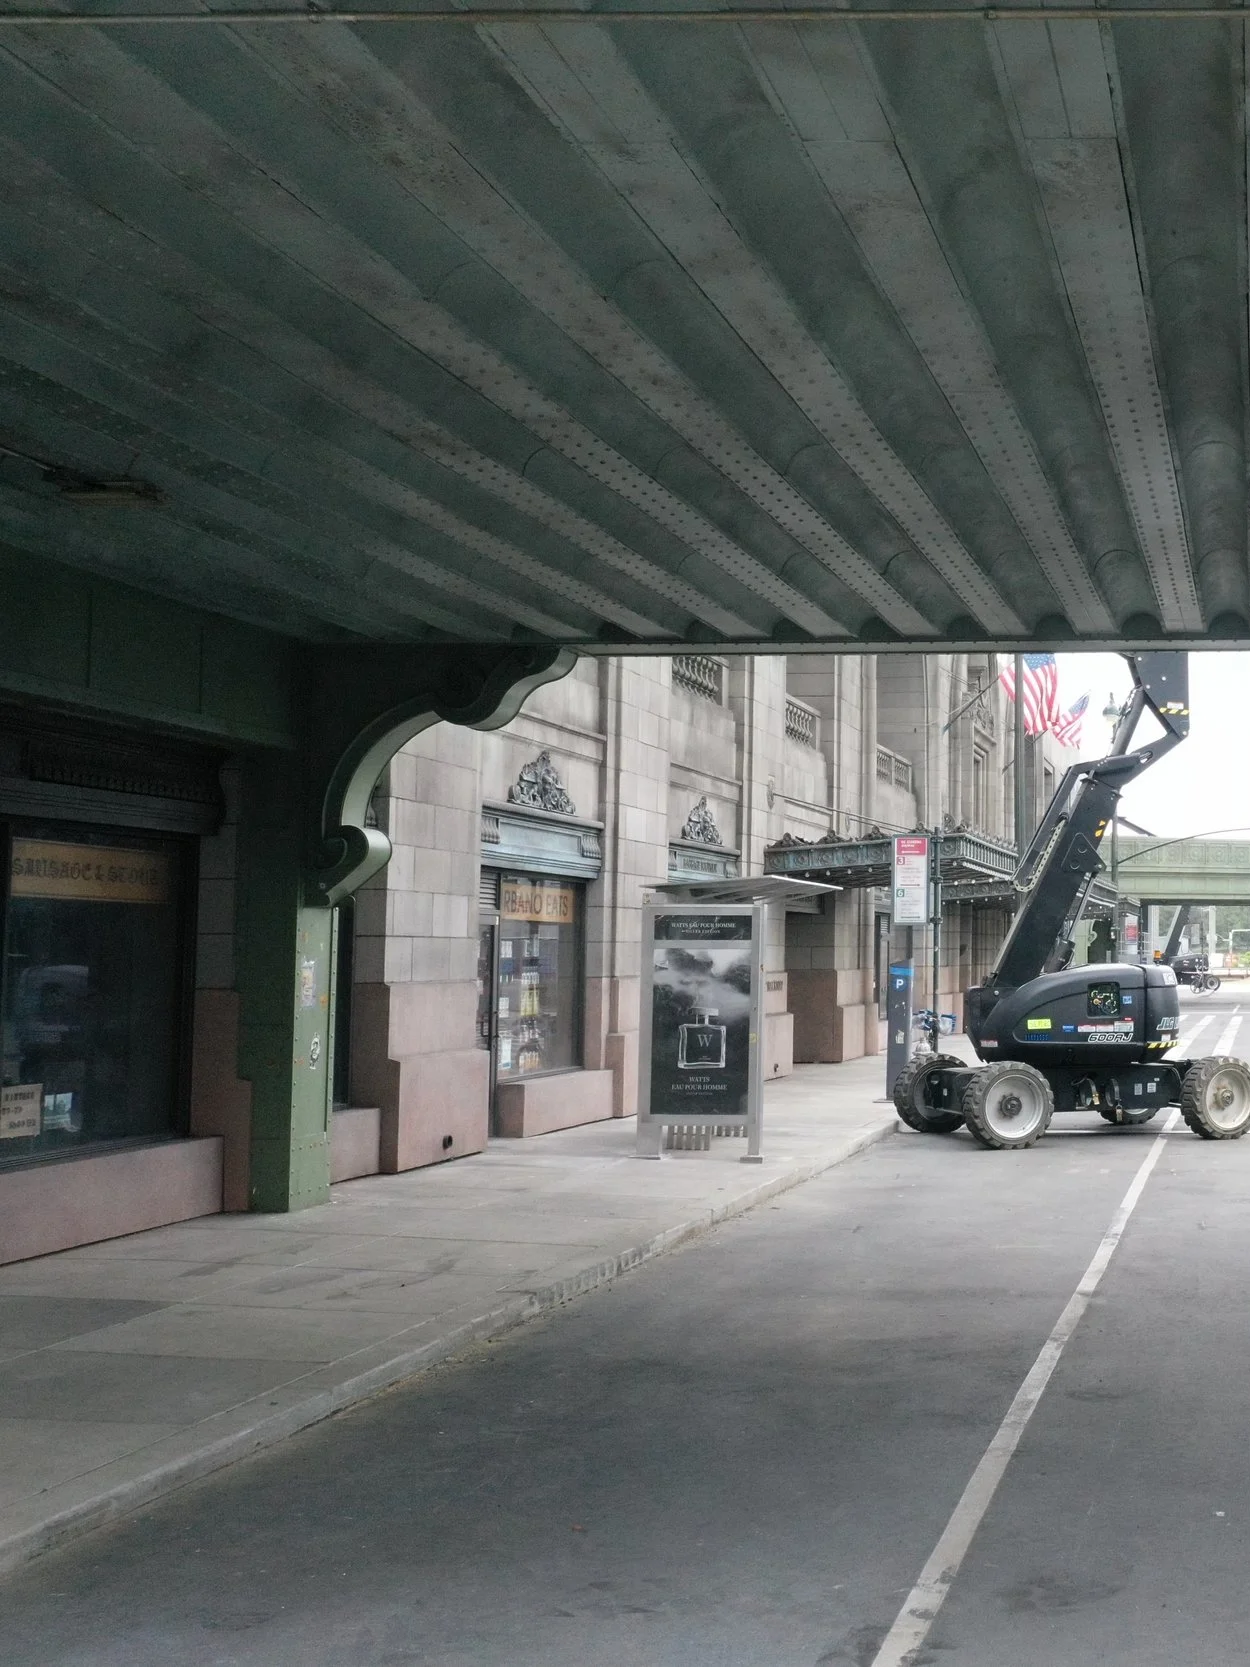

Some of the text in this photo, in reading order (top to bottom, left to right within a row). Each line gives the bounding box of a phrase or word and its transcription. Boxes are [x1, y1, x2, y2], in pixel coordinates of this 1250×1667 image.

[545, 895, 569, 916] EATS
[896, 979, 904, 988] P
[1156, 1017, 1174, 1030] JLG
[697, 1034, 713, 1047] W
[1088, 1033, 1133, 1042] 600AJ
